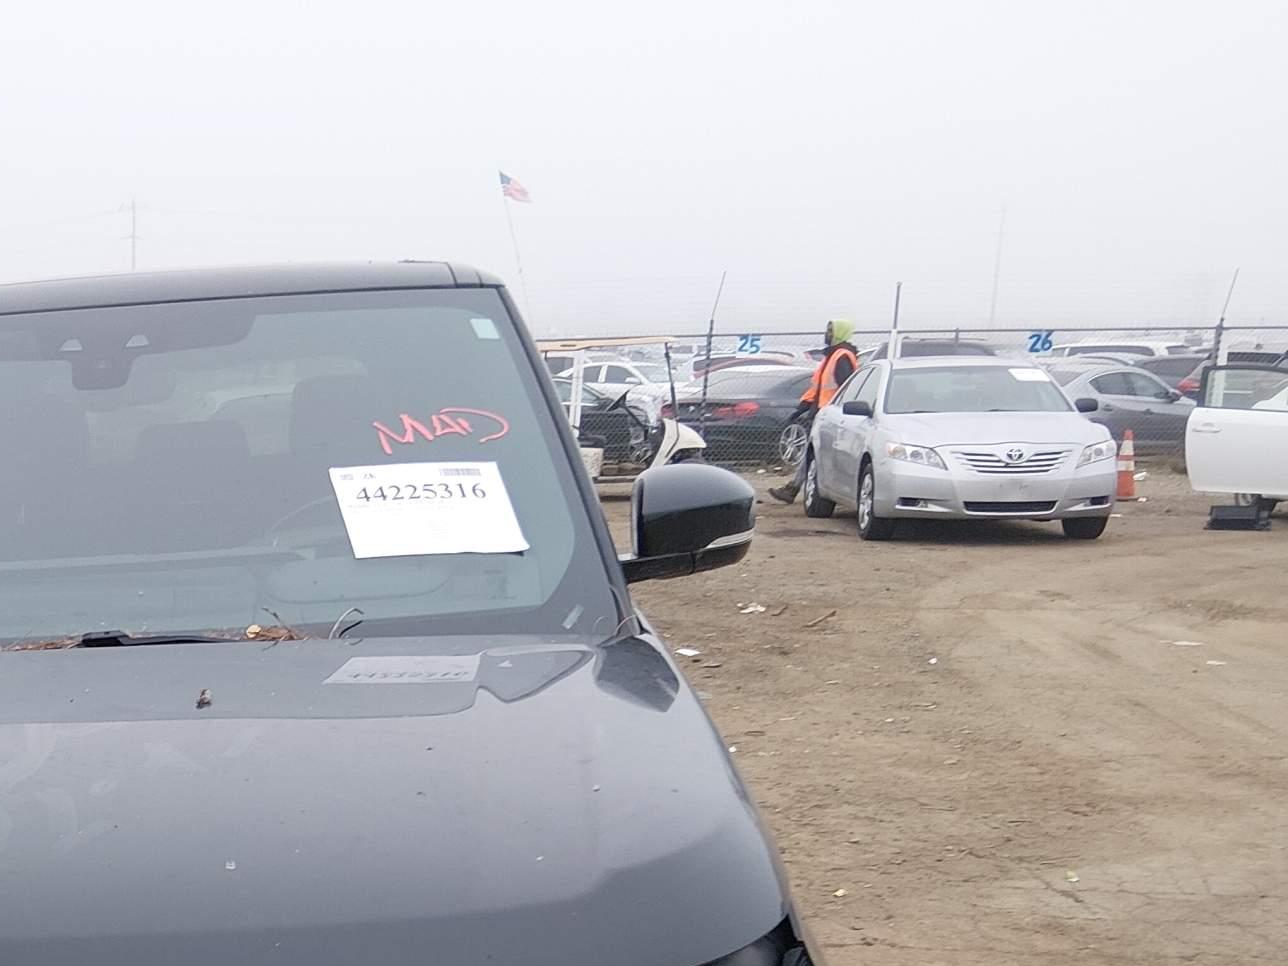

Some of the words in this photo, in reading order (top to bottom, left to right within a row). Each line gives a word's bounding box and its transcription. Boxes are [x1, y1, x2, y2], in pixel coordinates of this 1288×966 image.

[738, 335, 761, 354] 25
[1028, 332, 1053, 353] 26
[356, 482, 487, 502] 44225316
